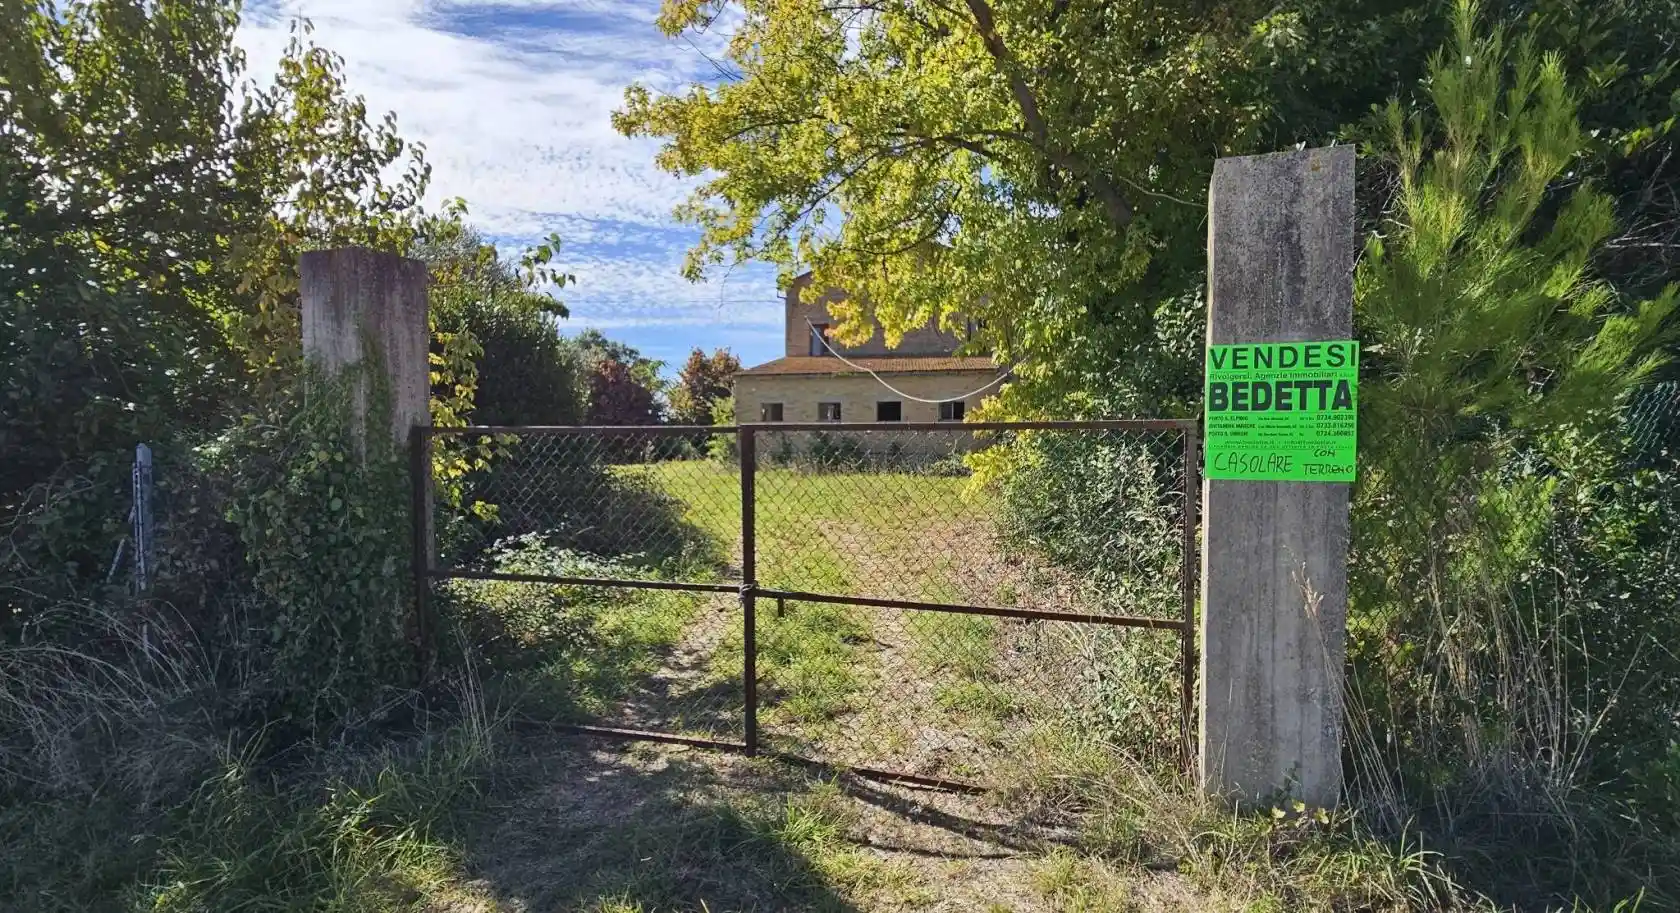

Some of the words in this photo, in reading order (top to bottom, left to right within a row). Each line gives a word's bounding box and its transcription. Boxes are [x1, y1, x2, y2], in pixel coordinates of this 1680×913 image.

[1209, 344, 1356, 370] VENDESI
[1255, 371, 1288, 381] Agenzie
[1289, 370, 1338, 380] Immobiliari
[1208, 379, 1354, 412] BEDETTA
[1214, 451, 1294, 475] CASOLARE
[1302, 463, 1354, 476] TERRENO
